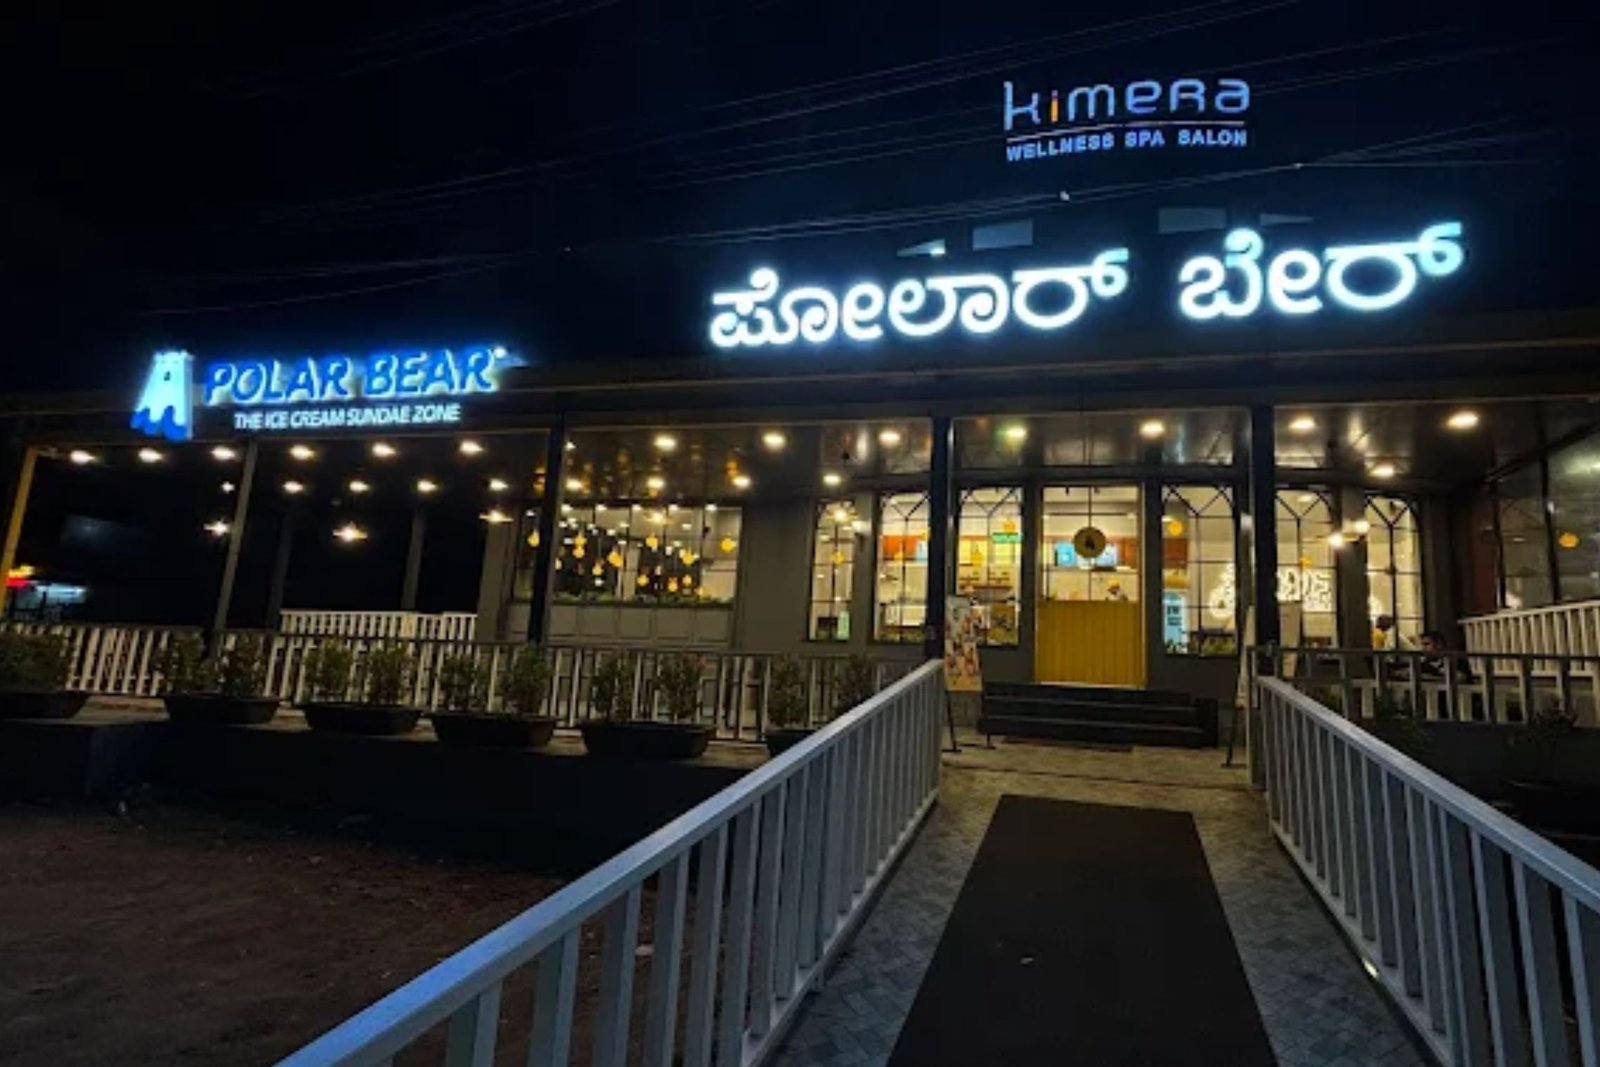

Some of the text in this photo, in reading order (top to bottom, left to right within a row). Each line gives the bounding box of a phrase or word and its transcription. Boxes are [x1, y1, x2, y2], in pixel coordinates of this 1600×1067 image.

[1006, 129, 1247, 162] WELLNESS SPA SALON
[1178, 222, 1463, 319] ಬೇರ್
[205, 355, 354, 405] POLAR
[234, 403, 461, 430] THE ICE CREAM SUNDAE ZONE
